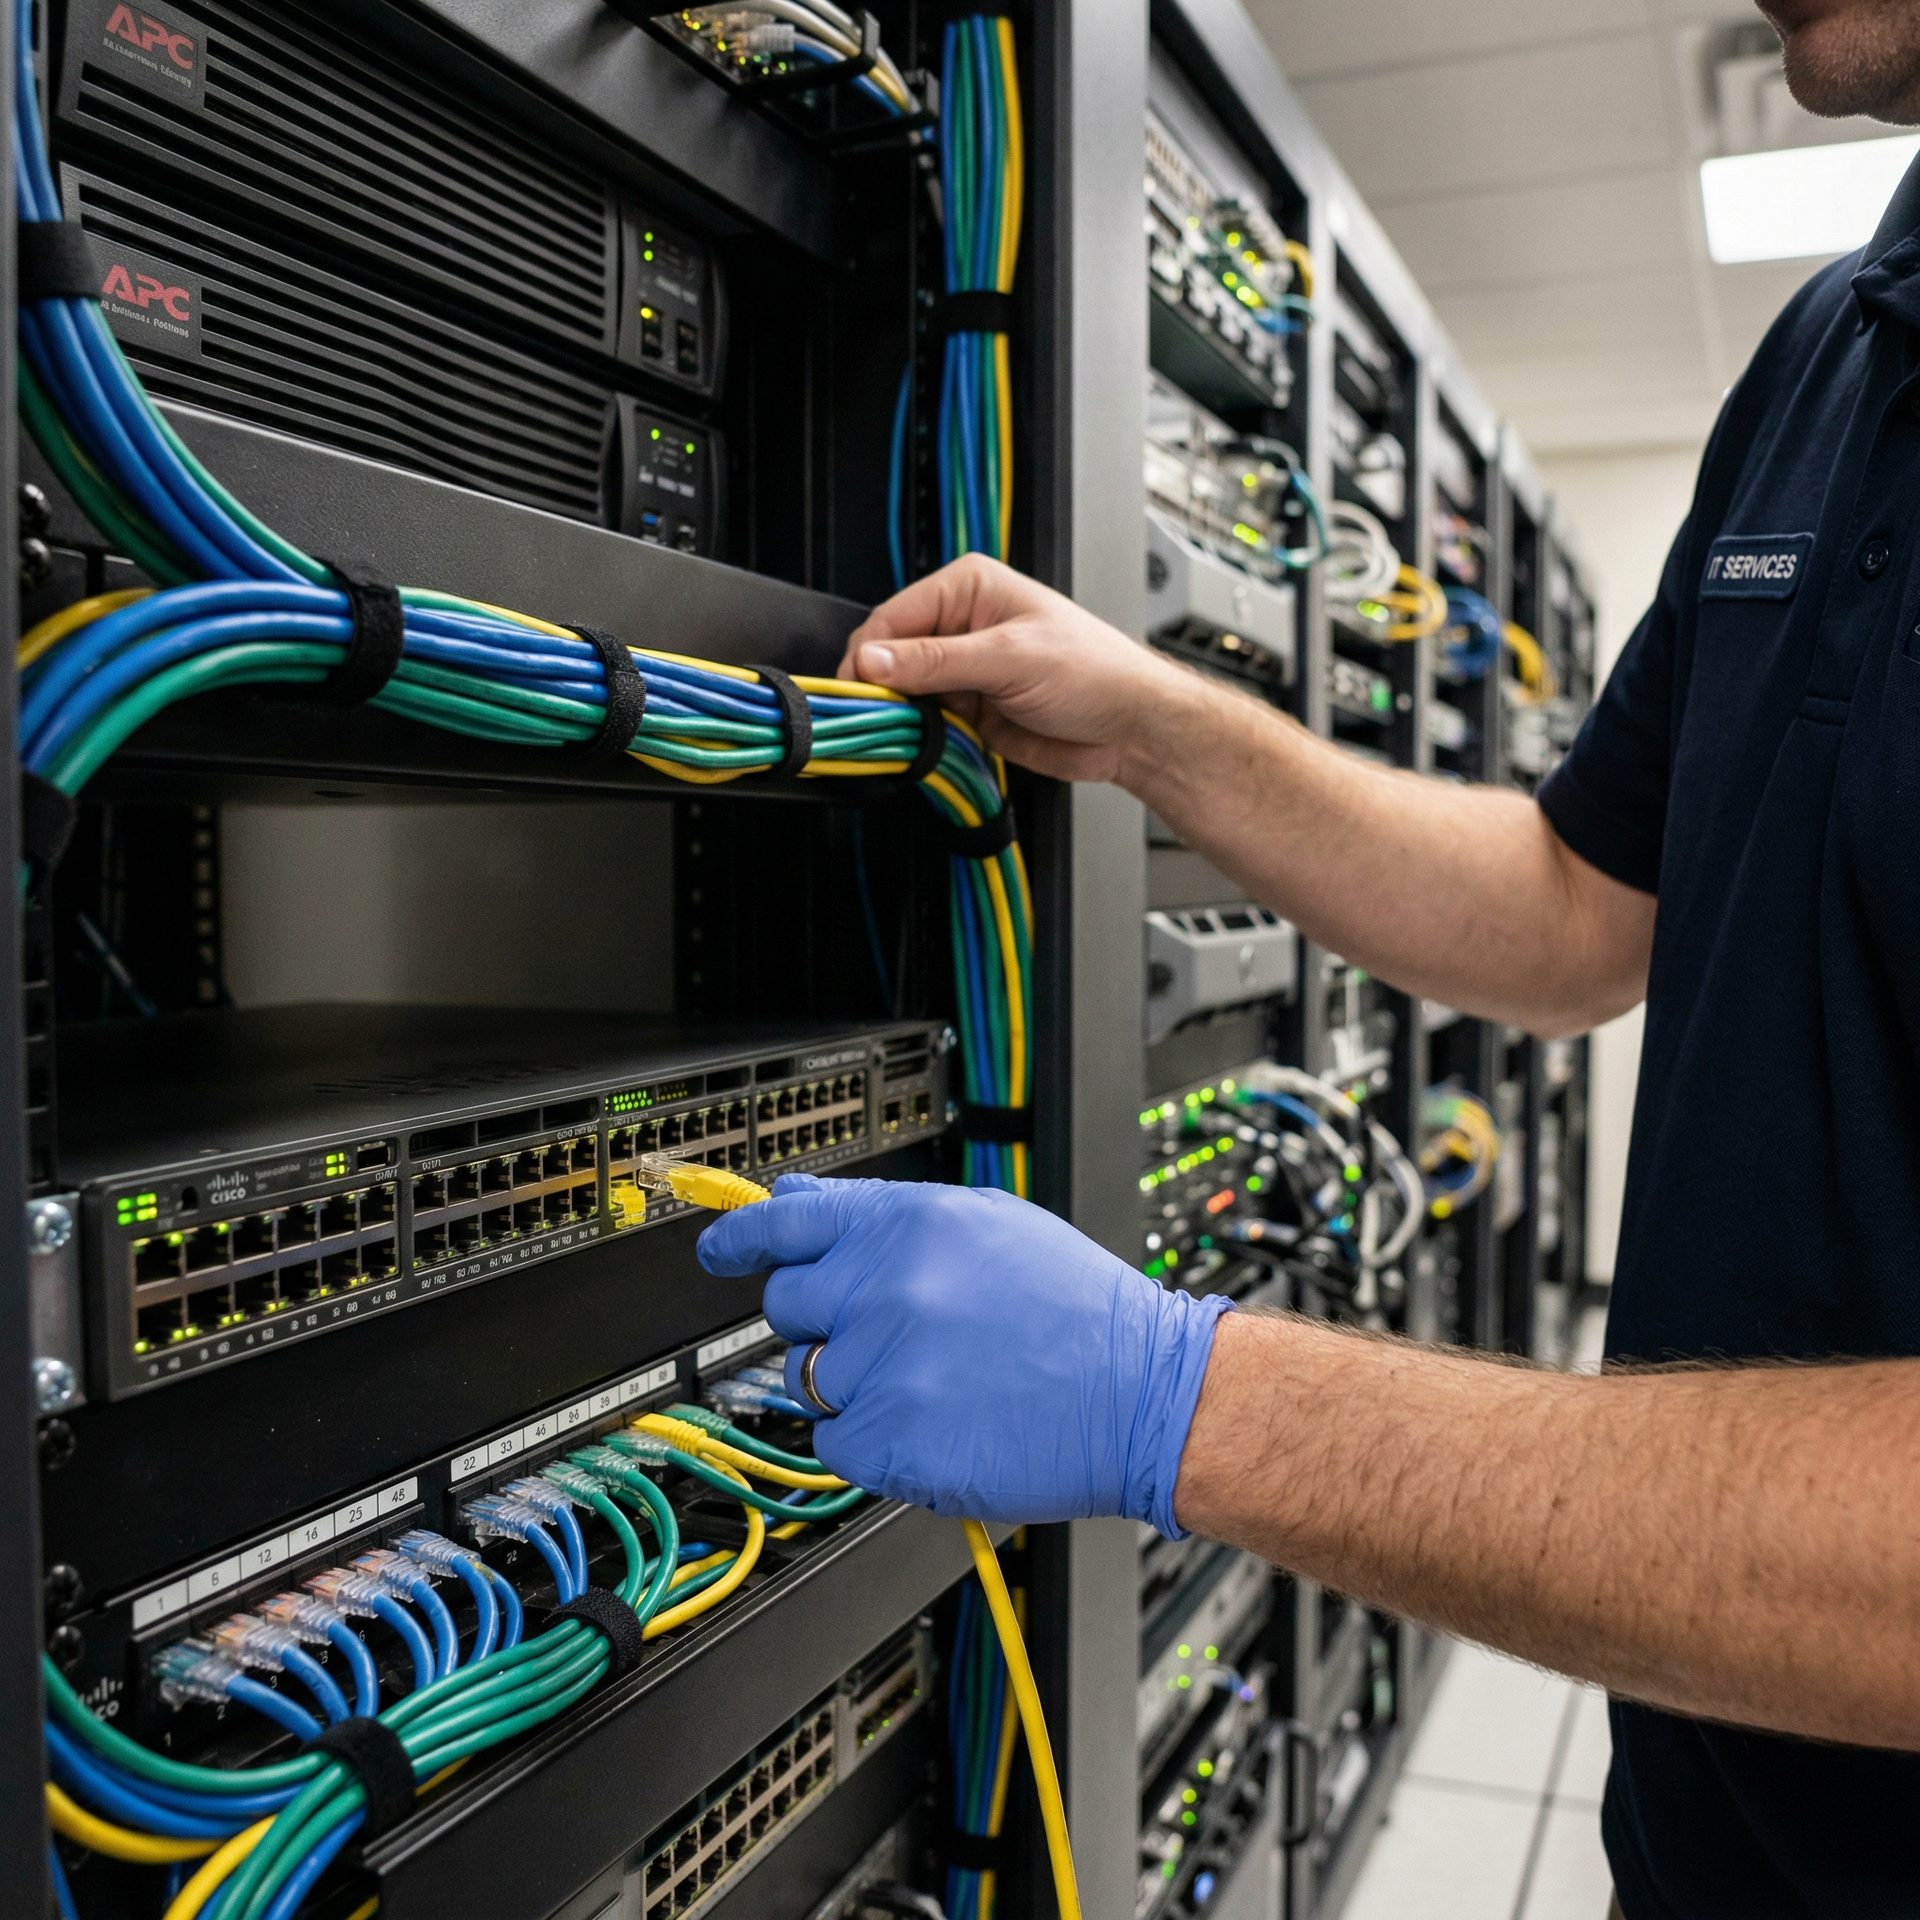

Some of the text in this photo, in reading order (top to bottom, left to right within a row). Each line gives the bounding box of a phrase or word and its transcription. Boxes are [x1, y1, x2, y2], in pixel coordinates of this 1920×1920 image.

[105, 3, 194, 70] APC
[102, 264, 190, 321] APC
[1707, 554, 1797, 580] IT SERVICES
[463, 1456, 476, 1471] 22
[500, 1440, 512, 1454] 33
[157, 1596, 164, 1611] 1
[257, 1549, 272, 1565] 12
[305, 1526, 318, 1543] 16
